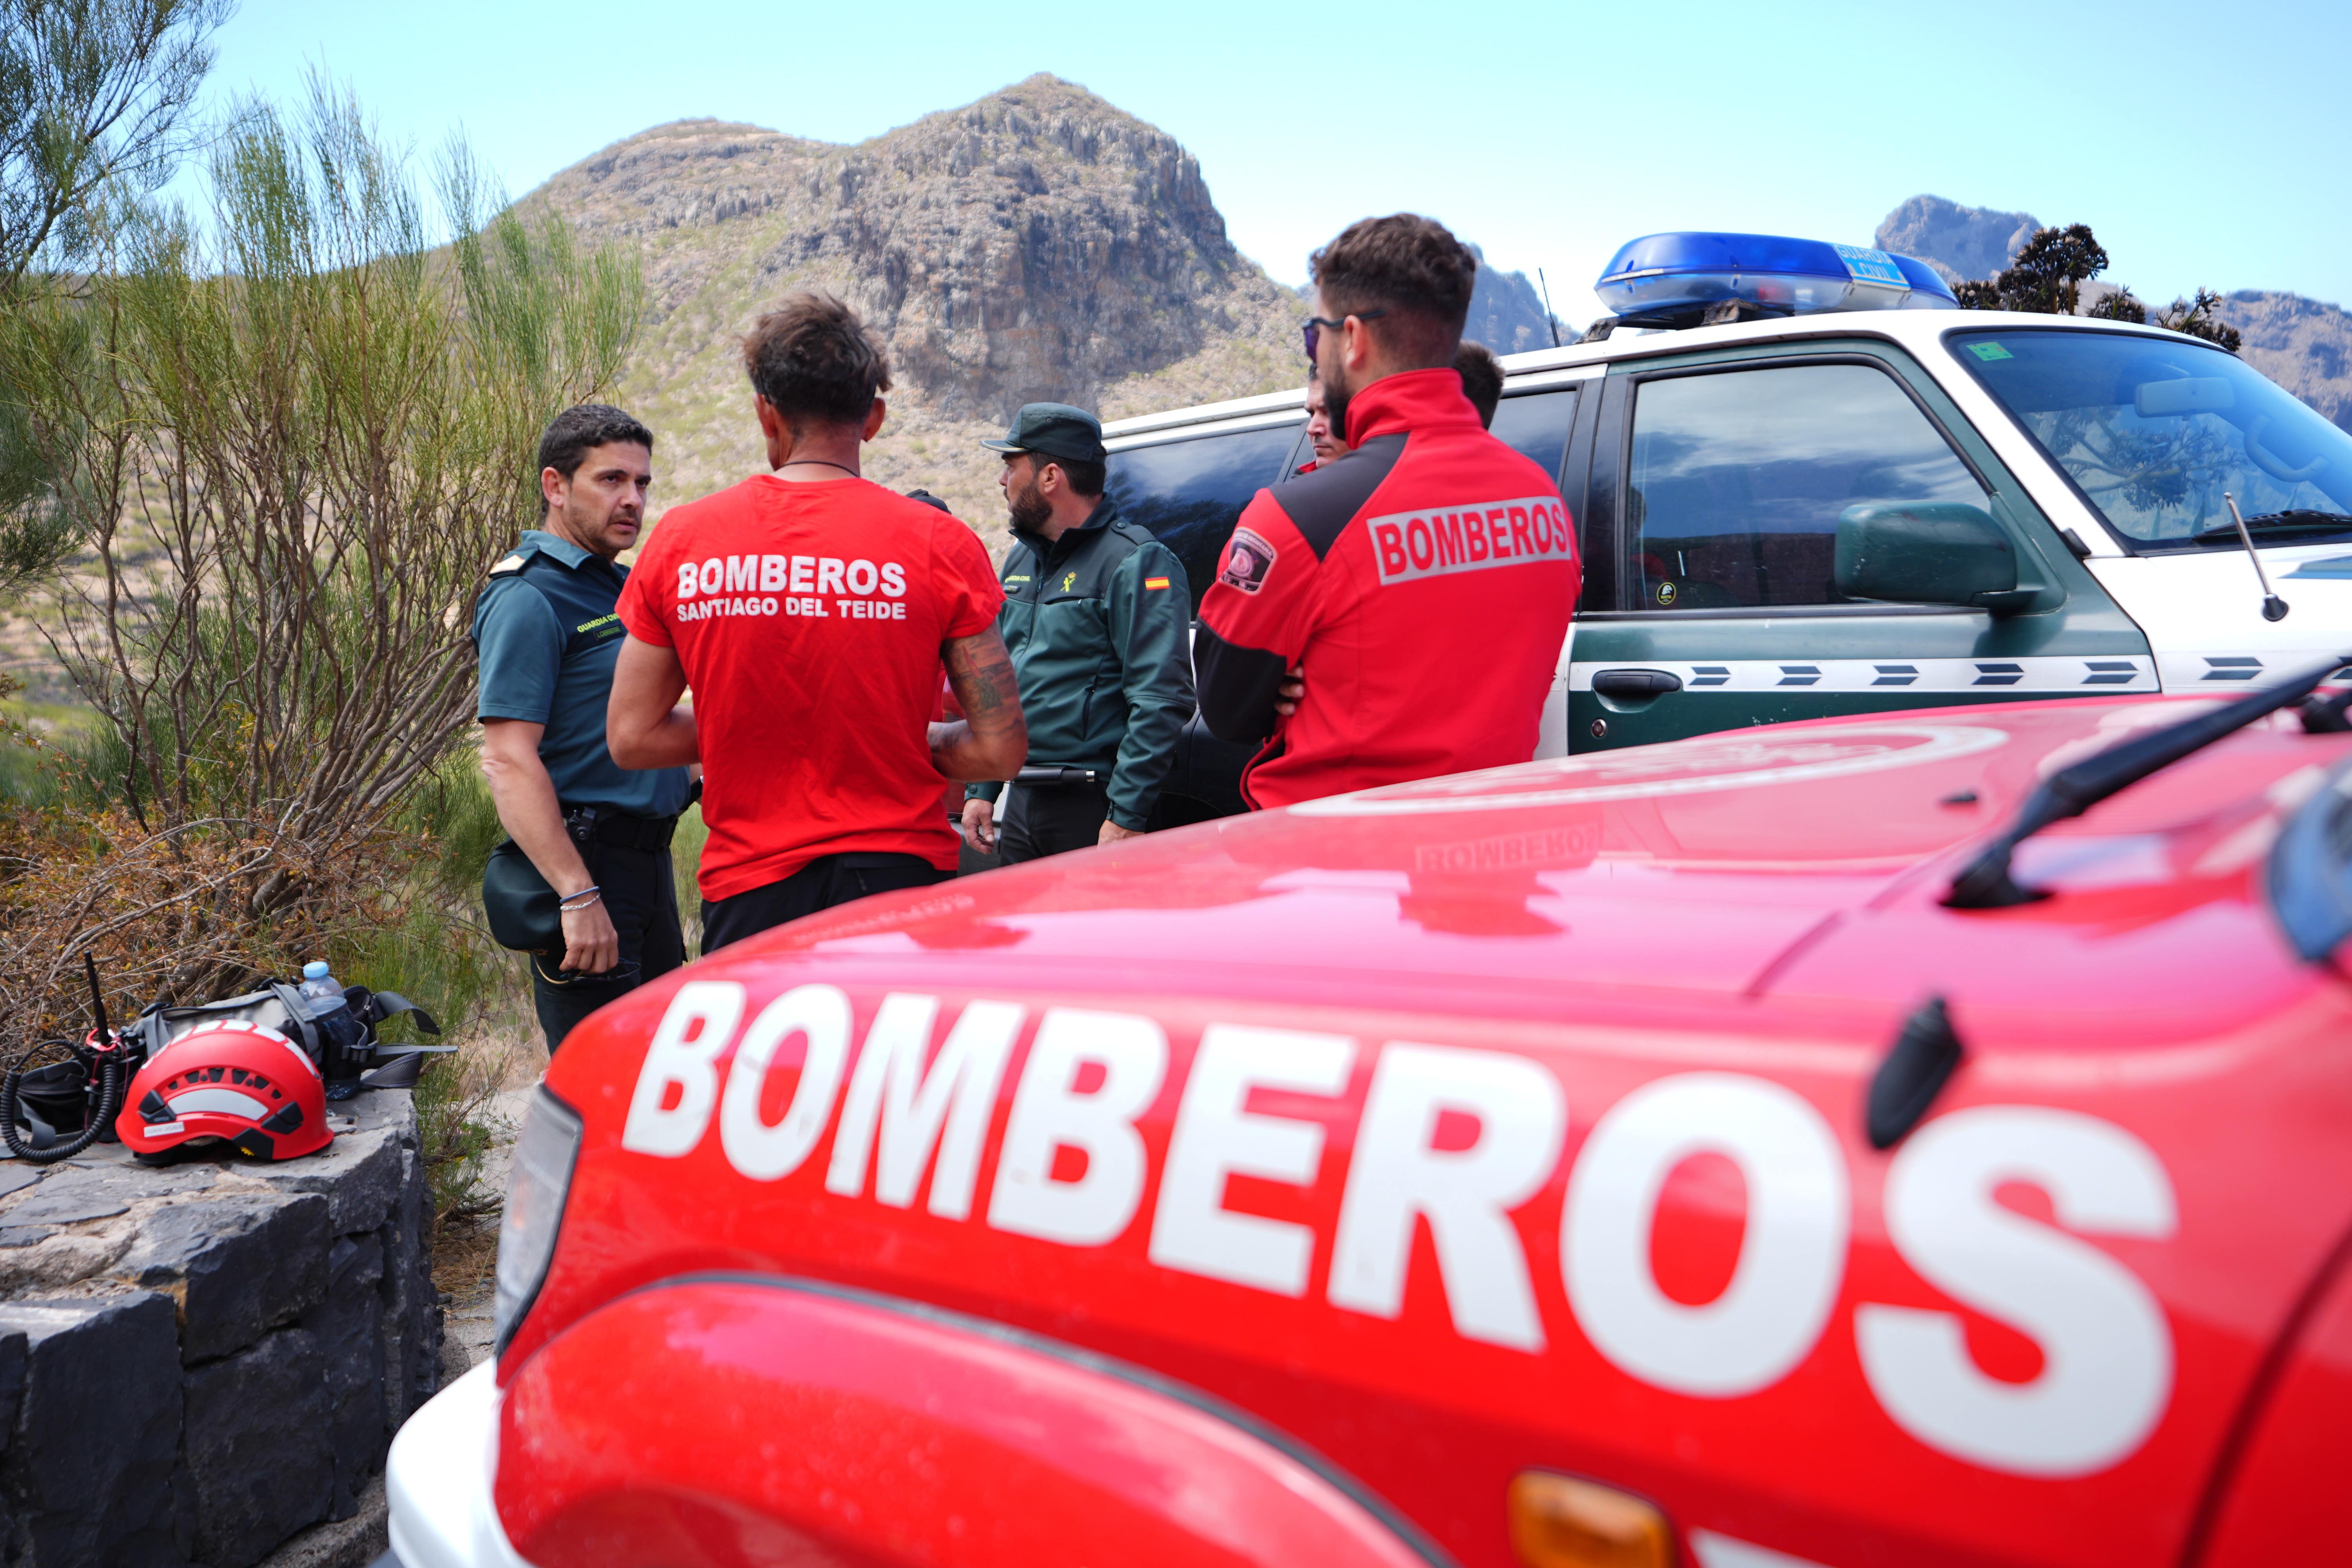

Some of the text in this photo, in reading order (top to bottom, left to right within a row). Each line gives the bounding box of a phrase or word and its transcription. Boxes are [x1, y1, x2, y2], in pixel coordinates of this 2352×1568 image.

[1833, 244, 1896, 265] GUARDIA
[1858, 262, 1891, 279] CIVIL
[1375, 503, 1567, 576] BOMBEROS
[677, 554, 906, 599] BOMBEROS
[677, 597, 906, 622] SANTIAGO DEL TEIDE
[577, 616, 609, 633] GUARDIA
[622, 980, 2179, 1476] BOMBEROS
